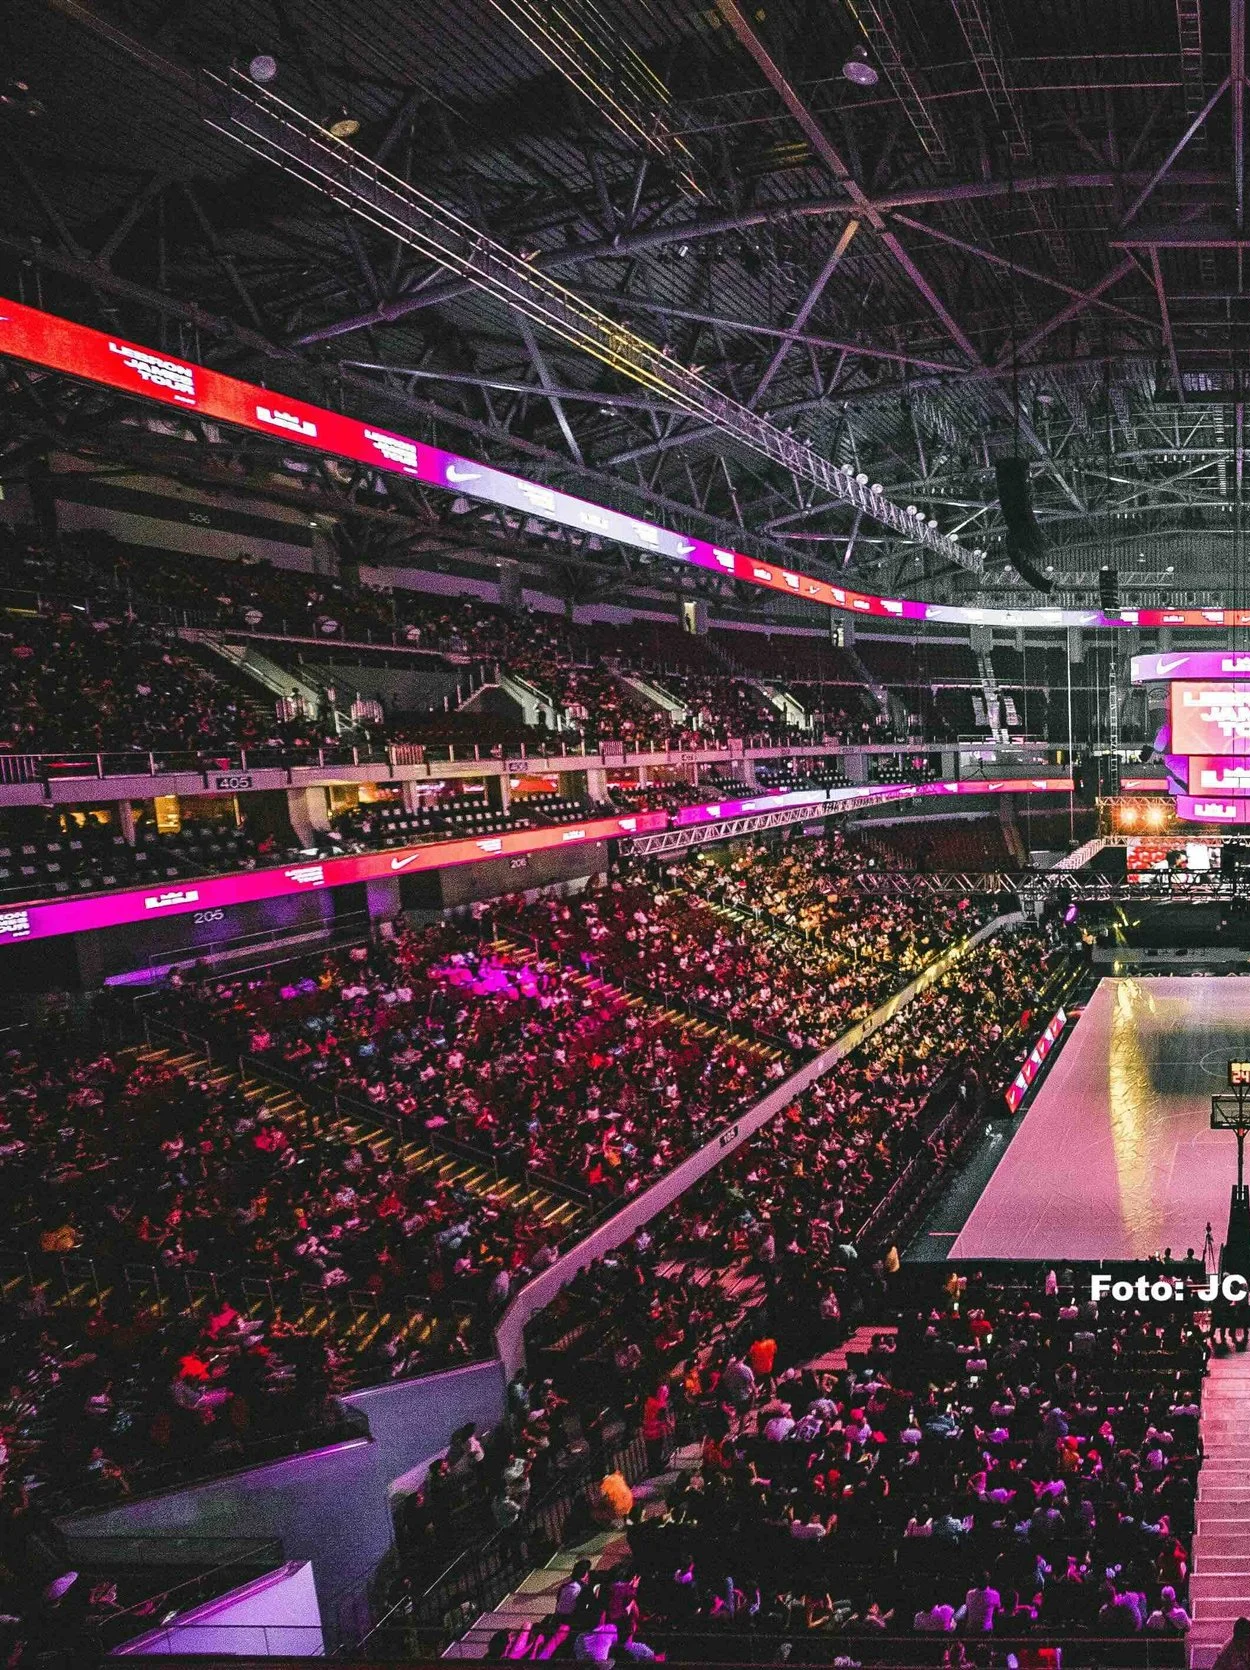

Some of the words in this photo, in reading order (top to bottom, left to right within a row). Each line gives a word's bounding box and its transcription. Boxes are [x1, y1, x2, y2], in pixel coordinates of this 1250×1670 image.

[220, 777, 249, 789] 405
[193, 909, 225, 924] 205
[1231, 1070, 1250, 1084] 24
